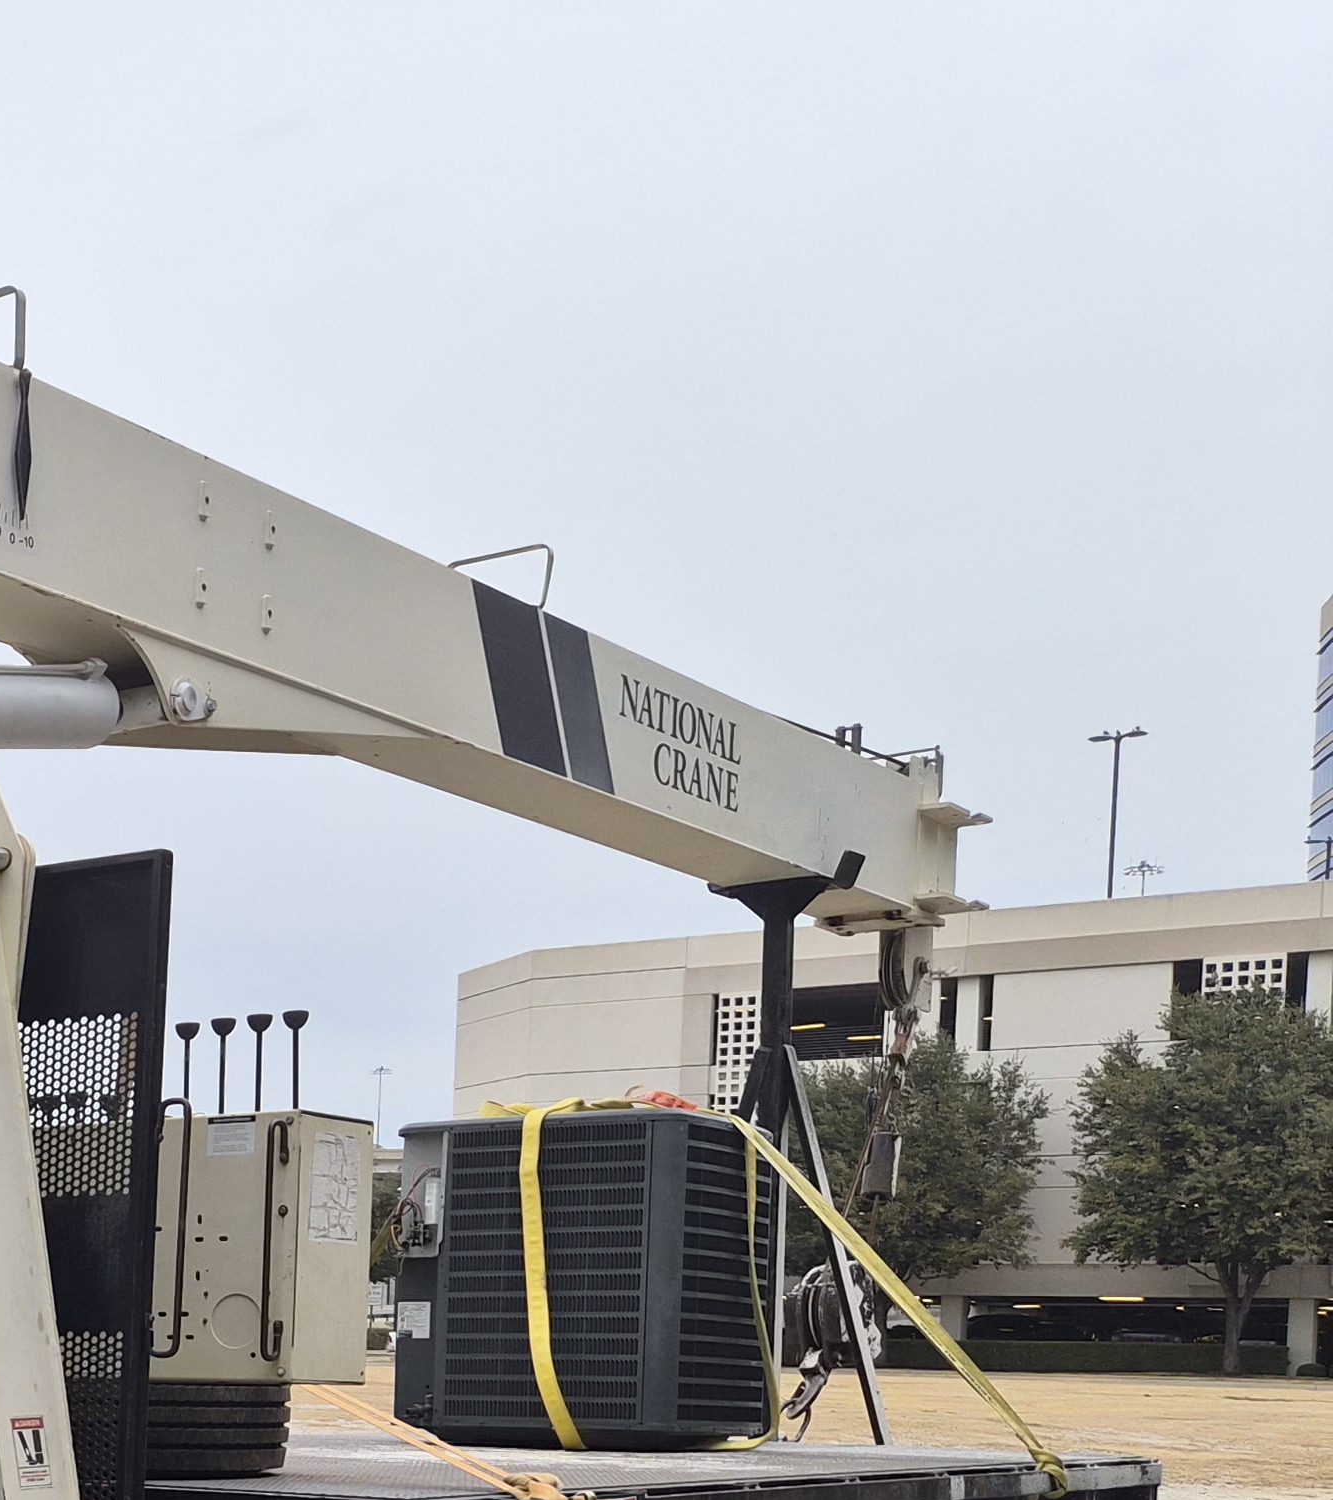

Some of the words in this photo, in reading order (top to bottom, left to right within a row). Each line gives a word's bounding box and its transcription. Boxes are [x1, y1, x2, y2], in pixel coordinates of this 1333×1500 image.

[9, 532, 16, 544] 0
[19, 536, 34, 548] -10
[619, 673, 742, 765] NATIONAL
[654, 742, 739, 813] CRANE
